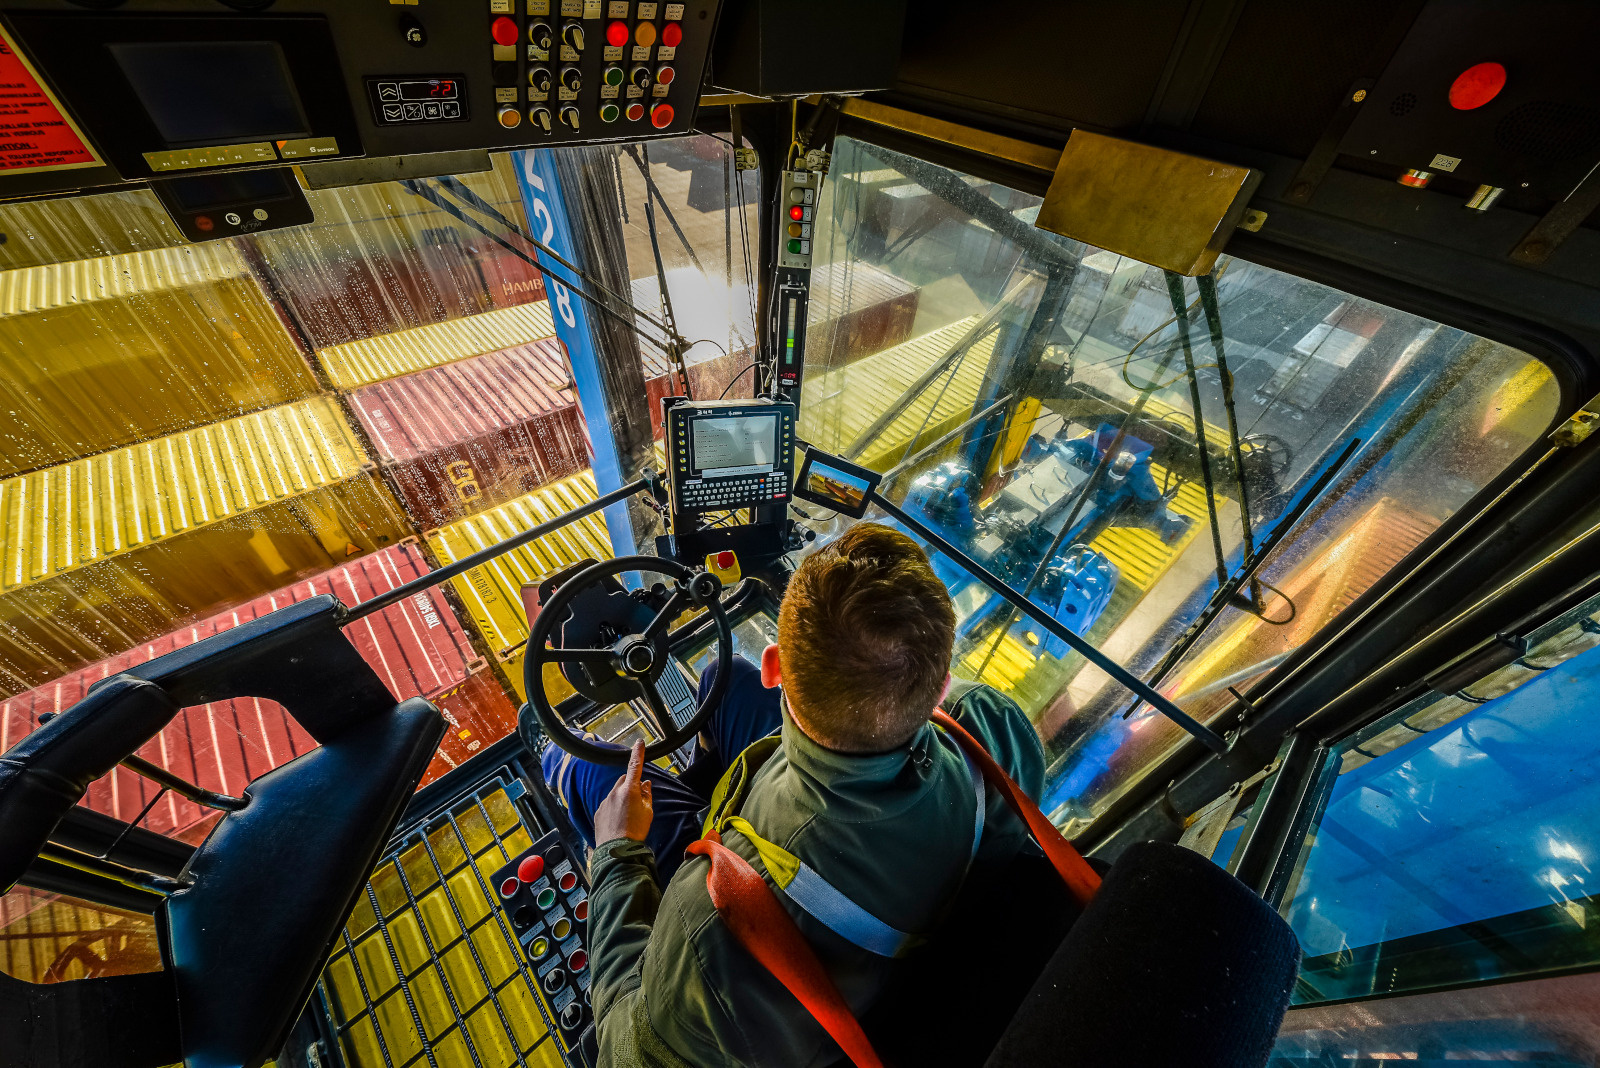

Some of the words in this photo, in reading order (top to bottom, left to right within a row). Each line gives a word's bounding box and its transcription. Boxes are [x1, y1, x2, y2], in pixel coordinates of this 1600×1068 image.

[430, 84, 451, 96] 22
[43, 149, 76, 157] REPOSER
[35, 156, 67, 164] SUPPORT
[1434, 157, 1454, 168] 228
[502, 279, 545, 296] HAMB
